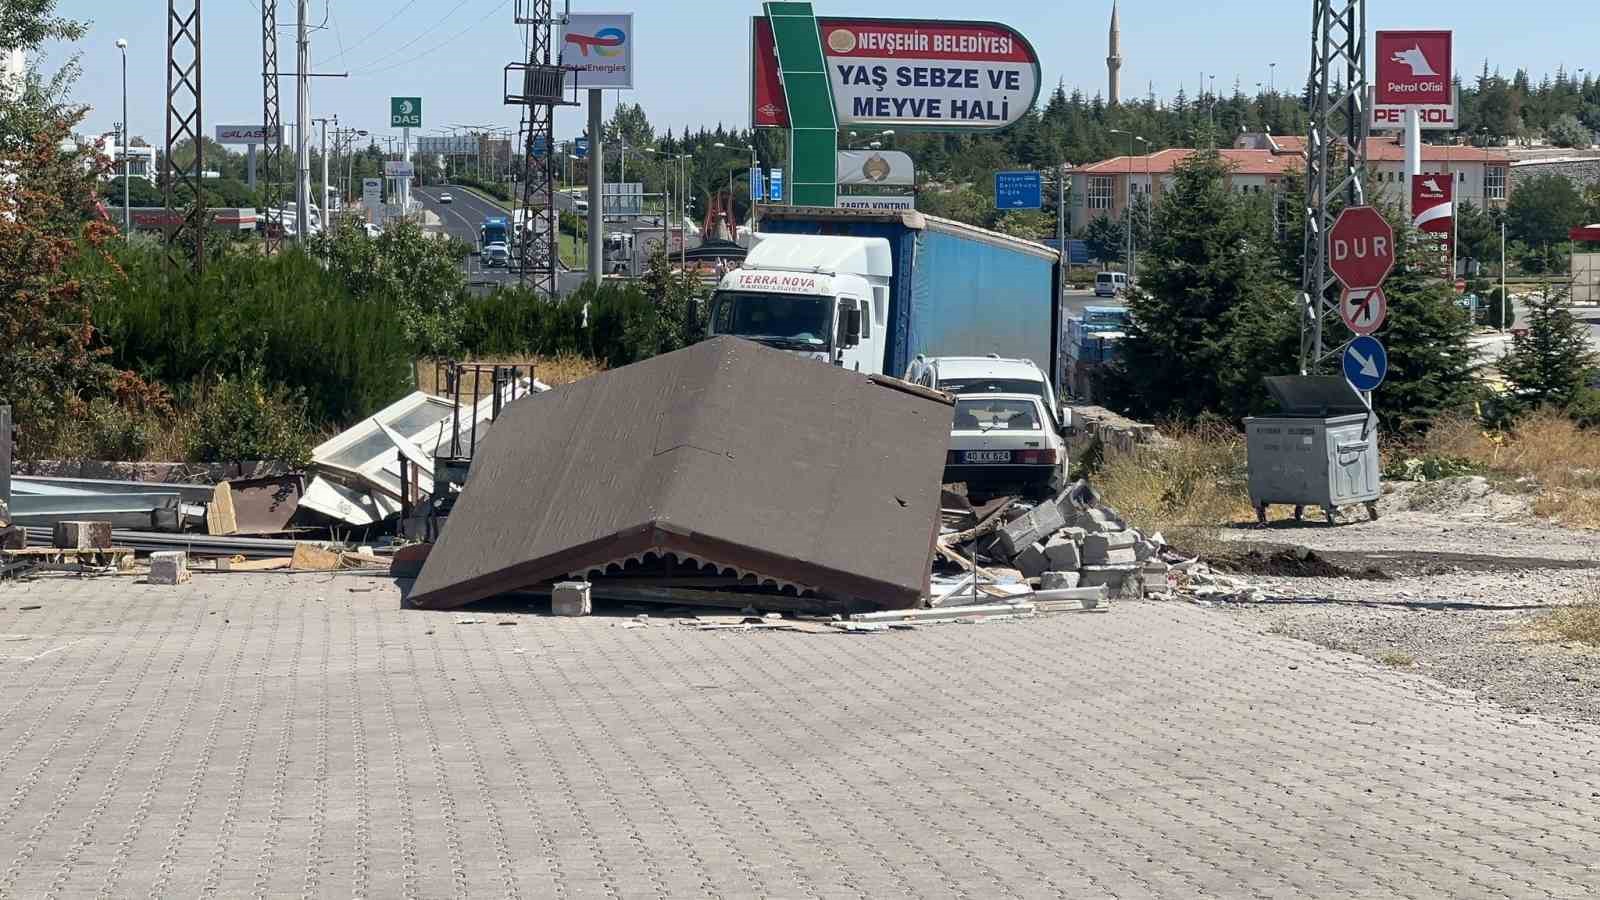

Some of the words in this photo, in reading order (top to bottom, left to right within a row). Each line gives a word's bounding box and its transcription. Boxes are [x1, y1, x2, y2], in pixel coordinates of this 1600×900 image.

[859, 30, 929, 54] NEVŞEHİR
[933, 33, 1013, 55] BELEDİYESİ
[837, 64, 888, 91] YAŞ
[896, 66, 979, 89] SEBZE
[987, 69, 1020, 90] VE
[1387, 82, 1418, 92] Petrol
[1419, 82, 1443, 92] Ofisi
[393, 115, 419, 124] DAS
[853, 96, 942, 118] MEYVE
[950, 96, 1008, 121] HALİ
[1335, 236, 1387, 261] DUR
[739, 275, 778, 285] TERRA
[782, 277, 816, 288] NOVA
